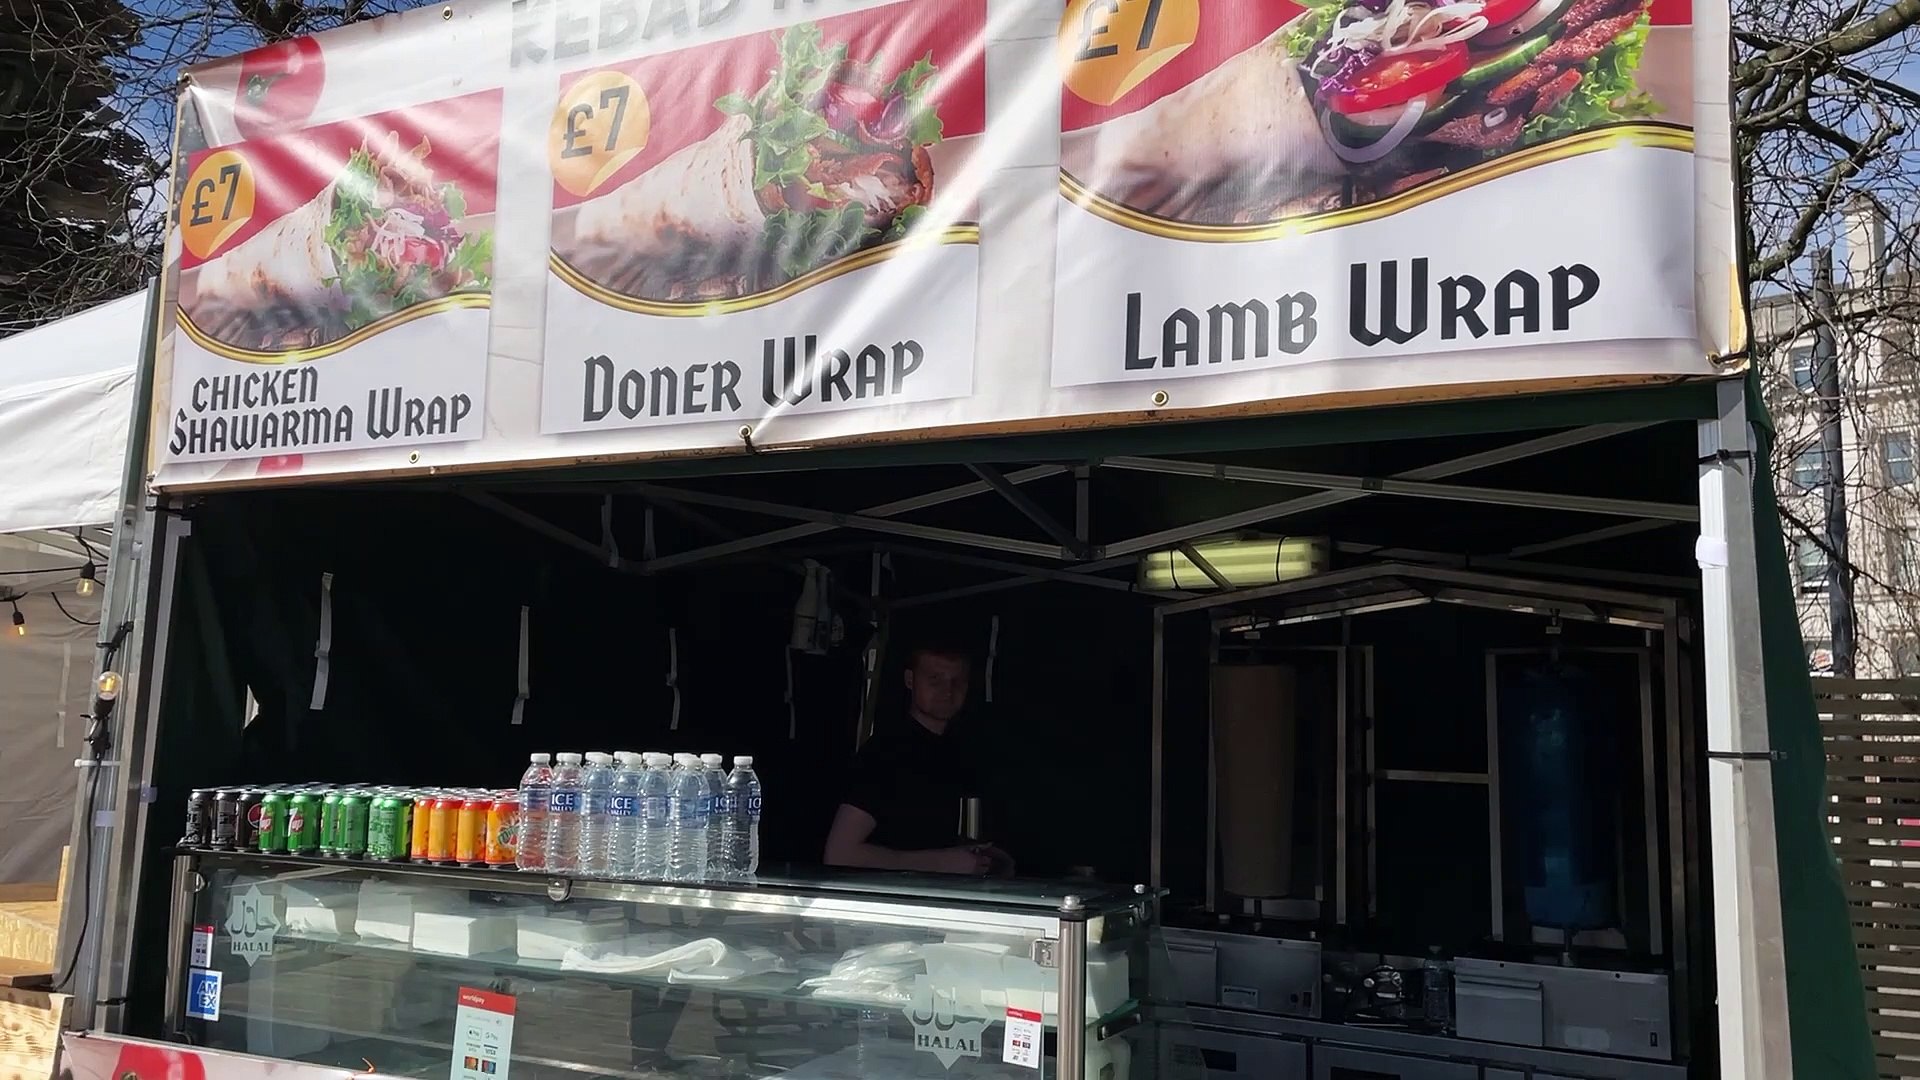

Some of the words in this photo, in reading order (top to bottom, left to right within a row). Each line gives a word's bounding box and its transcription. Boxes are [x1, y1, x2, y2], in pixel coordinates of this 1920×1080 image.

[561, 85, 629, 159] £7
[189, 163, 242, 227] £7
[1125, 291, 1318, 370] LAMB
[1349, 257, 1601, 347] WRAP
[191, 365, 318, 413] CHICKEN
[583, 354, 742, 422] DONER
[761, 334, 925, 407] WRAP
[169, 407, 354, 456] SHAWARMA
[366, 386, 472, 440] WRAP
[551, 794, 574, 805] ICE
[610, 797, 633, 809] ICE
[233, 942, 271, 953] HALAL
[197, 981, 217, 996] AM
[199, 994, 216, 1009] EX
[917, 1033, 979, 1052] HALAL
